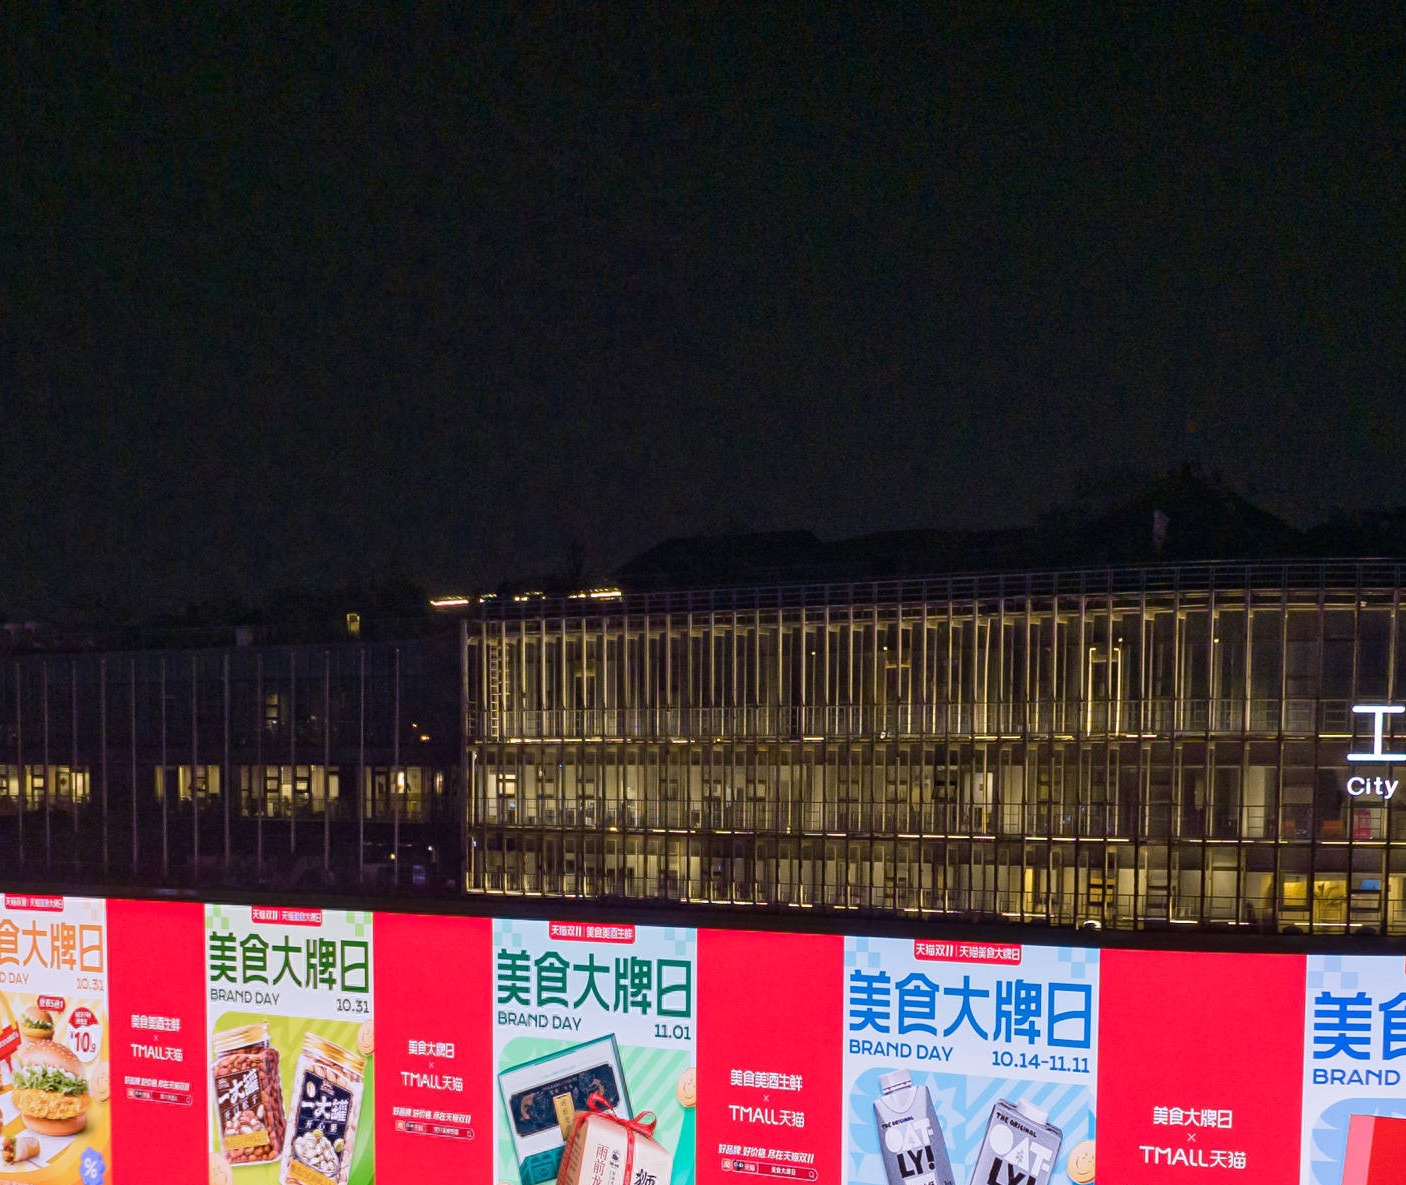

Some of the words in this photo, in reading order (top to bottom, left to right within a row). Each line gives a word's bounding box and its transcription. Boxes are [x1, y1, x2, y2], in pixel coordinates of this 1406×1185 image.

[1346, 776, 1399, 801] City
[209, 931, 369, 993] 美食大牌日
[959, 945, 1020, 961] 天猫美食大牌日
[8, 972, 29, 985] DAY
[77, 977, 104, 992] 10.31
[497, 948, 691, 1018] 美食大牌日
[210, 989, 252, 1004] BRAND
[255, 992, 280, 1006] DAY
[336, 998, 370, 1014] 10.31
[849, 969, 1092, 1049] 美食大牌日
[498, 1011, 549, 1028] BRAND
[552, 1016, 582, 1031] DAY
[655, 1024, 691, 1040] 11.01
[408, 1040, 455, 1058] 美食大牌日
[849, 1039, 912, 1058] BRAND
[916, 1044, 953, 1062] DAY
[992, 1051, 1090, 1074] 10.14-11.11
[730, 1069, 803, 1092] 美食美酒生鲜
[1312, 1068, 1401, 1085] BRAND
[301, 1096, 349, 1121] 一大罐
[729, 1105, 805, 1128] TMALL天猫
[1153, 1106, 1232, 1129] 美食大牌日
[996, 1112, 1009, 1122] THE
[1009, 1119, 1037, 1138] ORIGINAL
[897, 1145, 936, 1178] LY!
[1139, 1146, 1246, 1169] TMALL天猫
